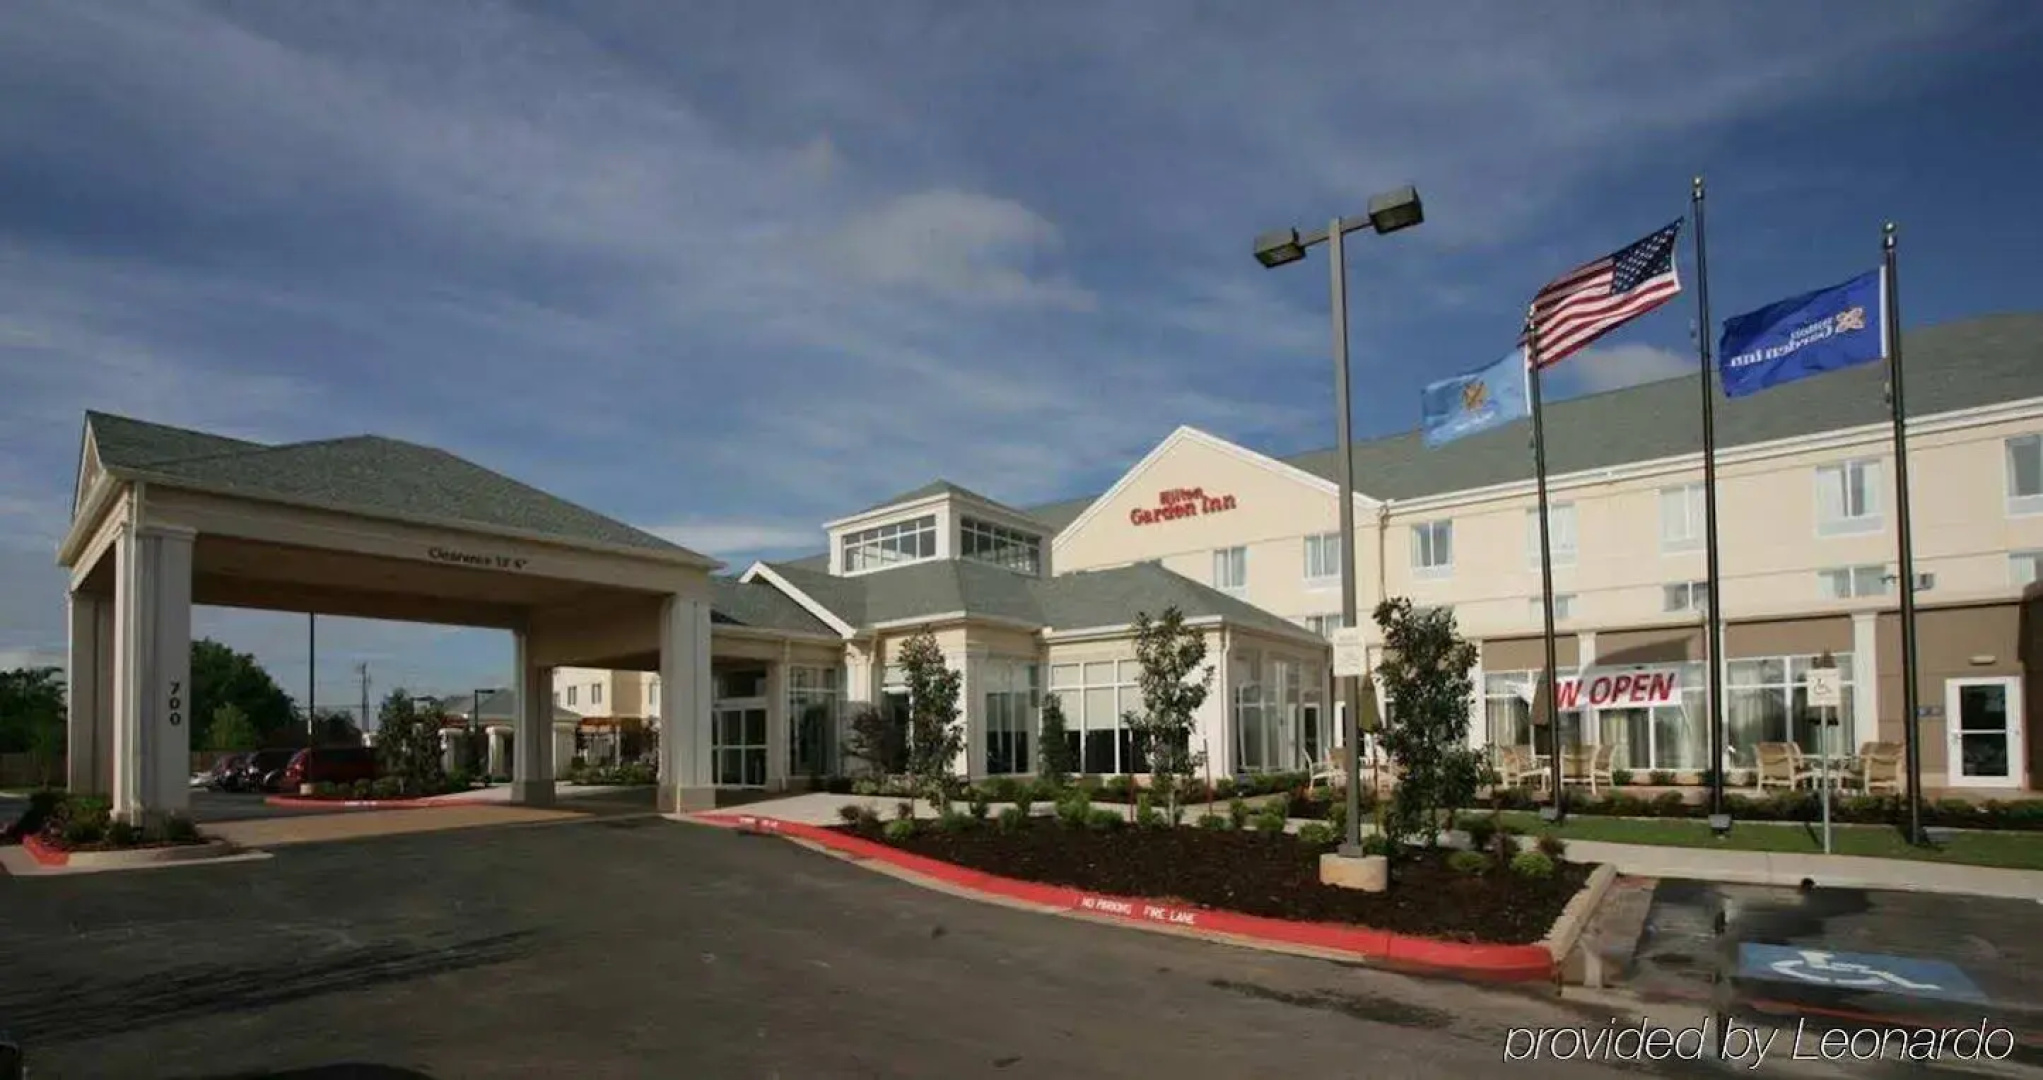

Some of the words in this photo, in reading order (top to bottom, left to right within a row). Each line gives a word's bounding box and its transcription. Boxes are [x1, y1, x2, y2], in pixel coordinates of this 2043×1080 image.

[1130, 502, 1197, 526] Garden
[1202, 494, 1237, 514] Inn
[428, 547, 493, 565] Clearance
[1589, 672, 1675, 705] OPEN
[169, 681, 182, 726] 700
[1082, 897, 1095, 909] NO
[1169, 909, 1196, 925] LANE
